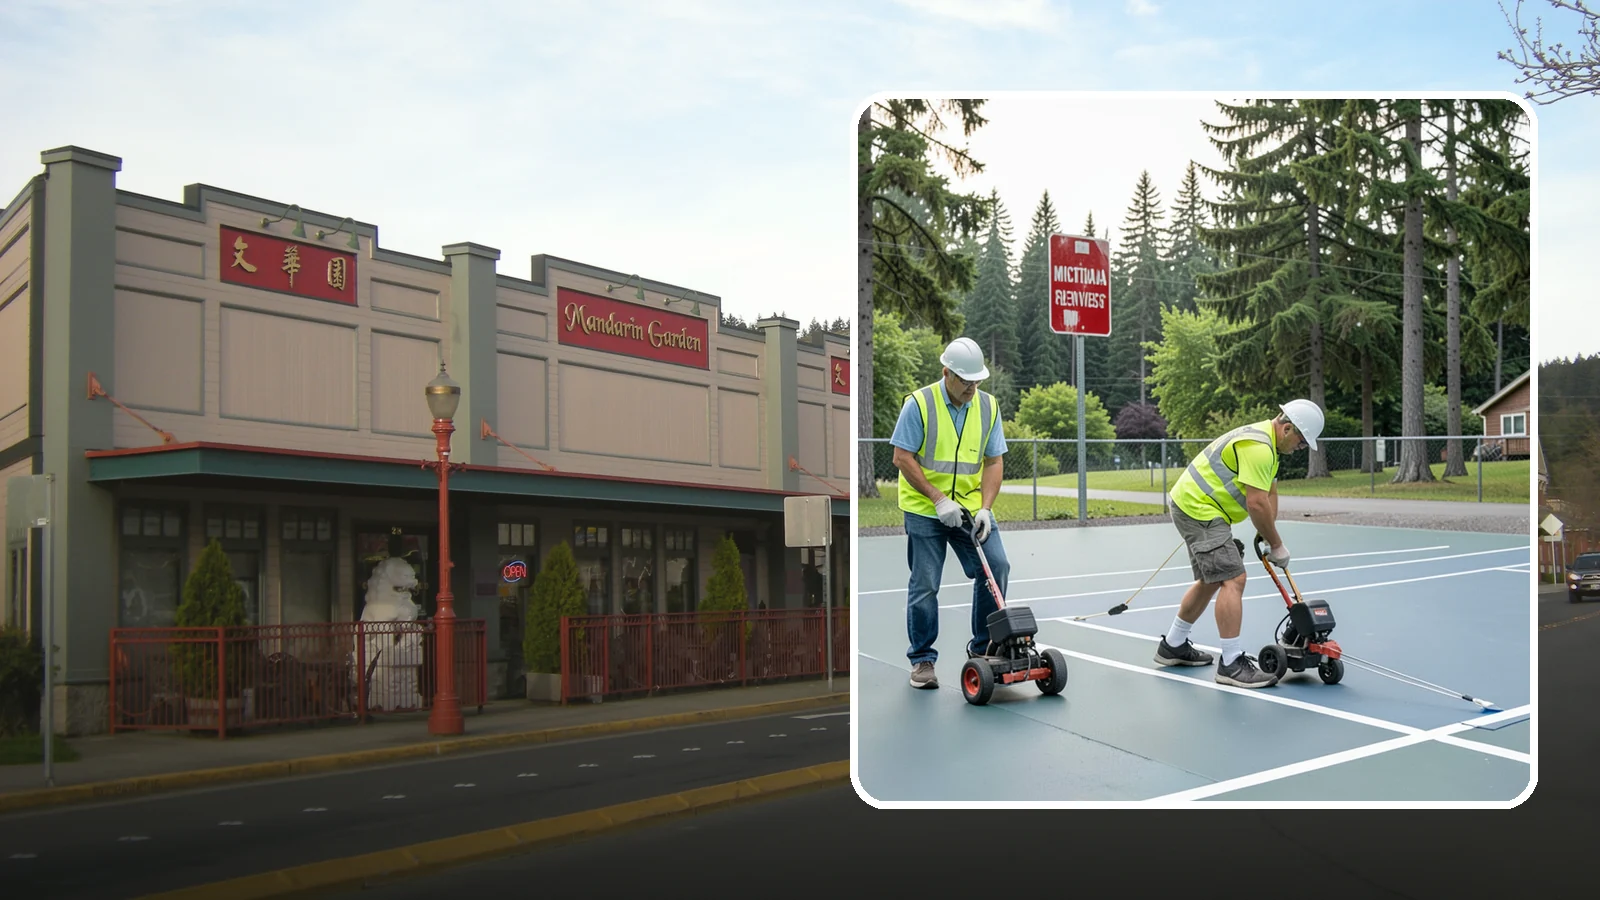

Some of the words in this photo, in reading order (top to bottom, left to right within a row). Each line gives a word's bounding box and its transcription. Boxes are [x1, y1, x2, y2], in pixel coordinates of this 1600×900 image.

[564, 302, 644, 341] Mandarin
[647, 320, 702, 352] Garden
[503, 565, 527, 578] OPEN
